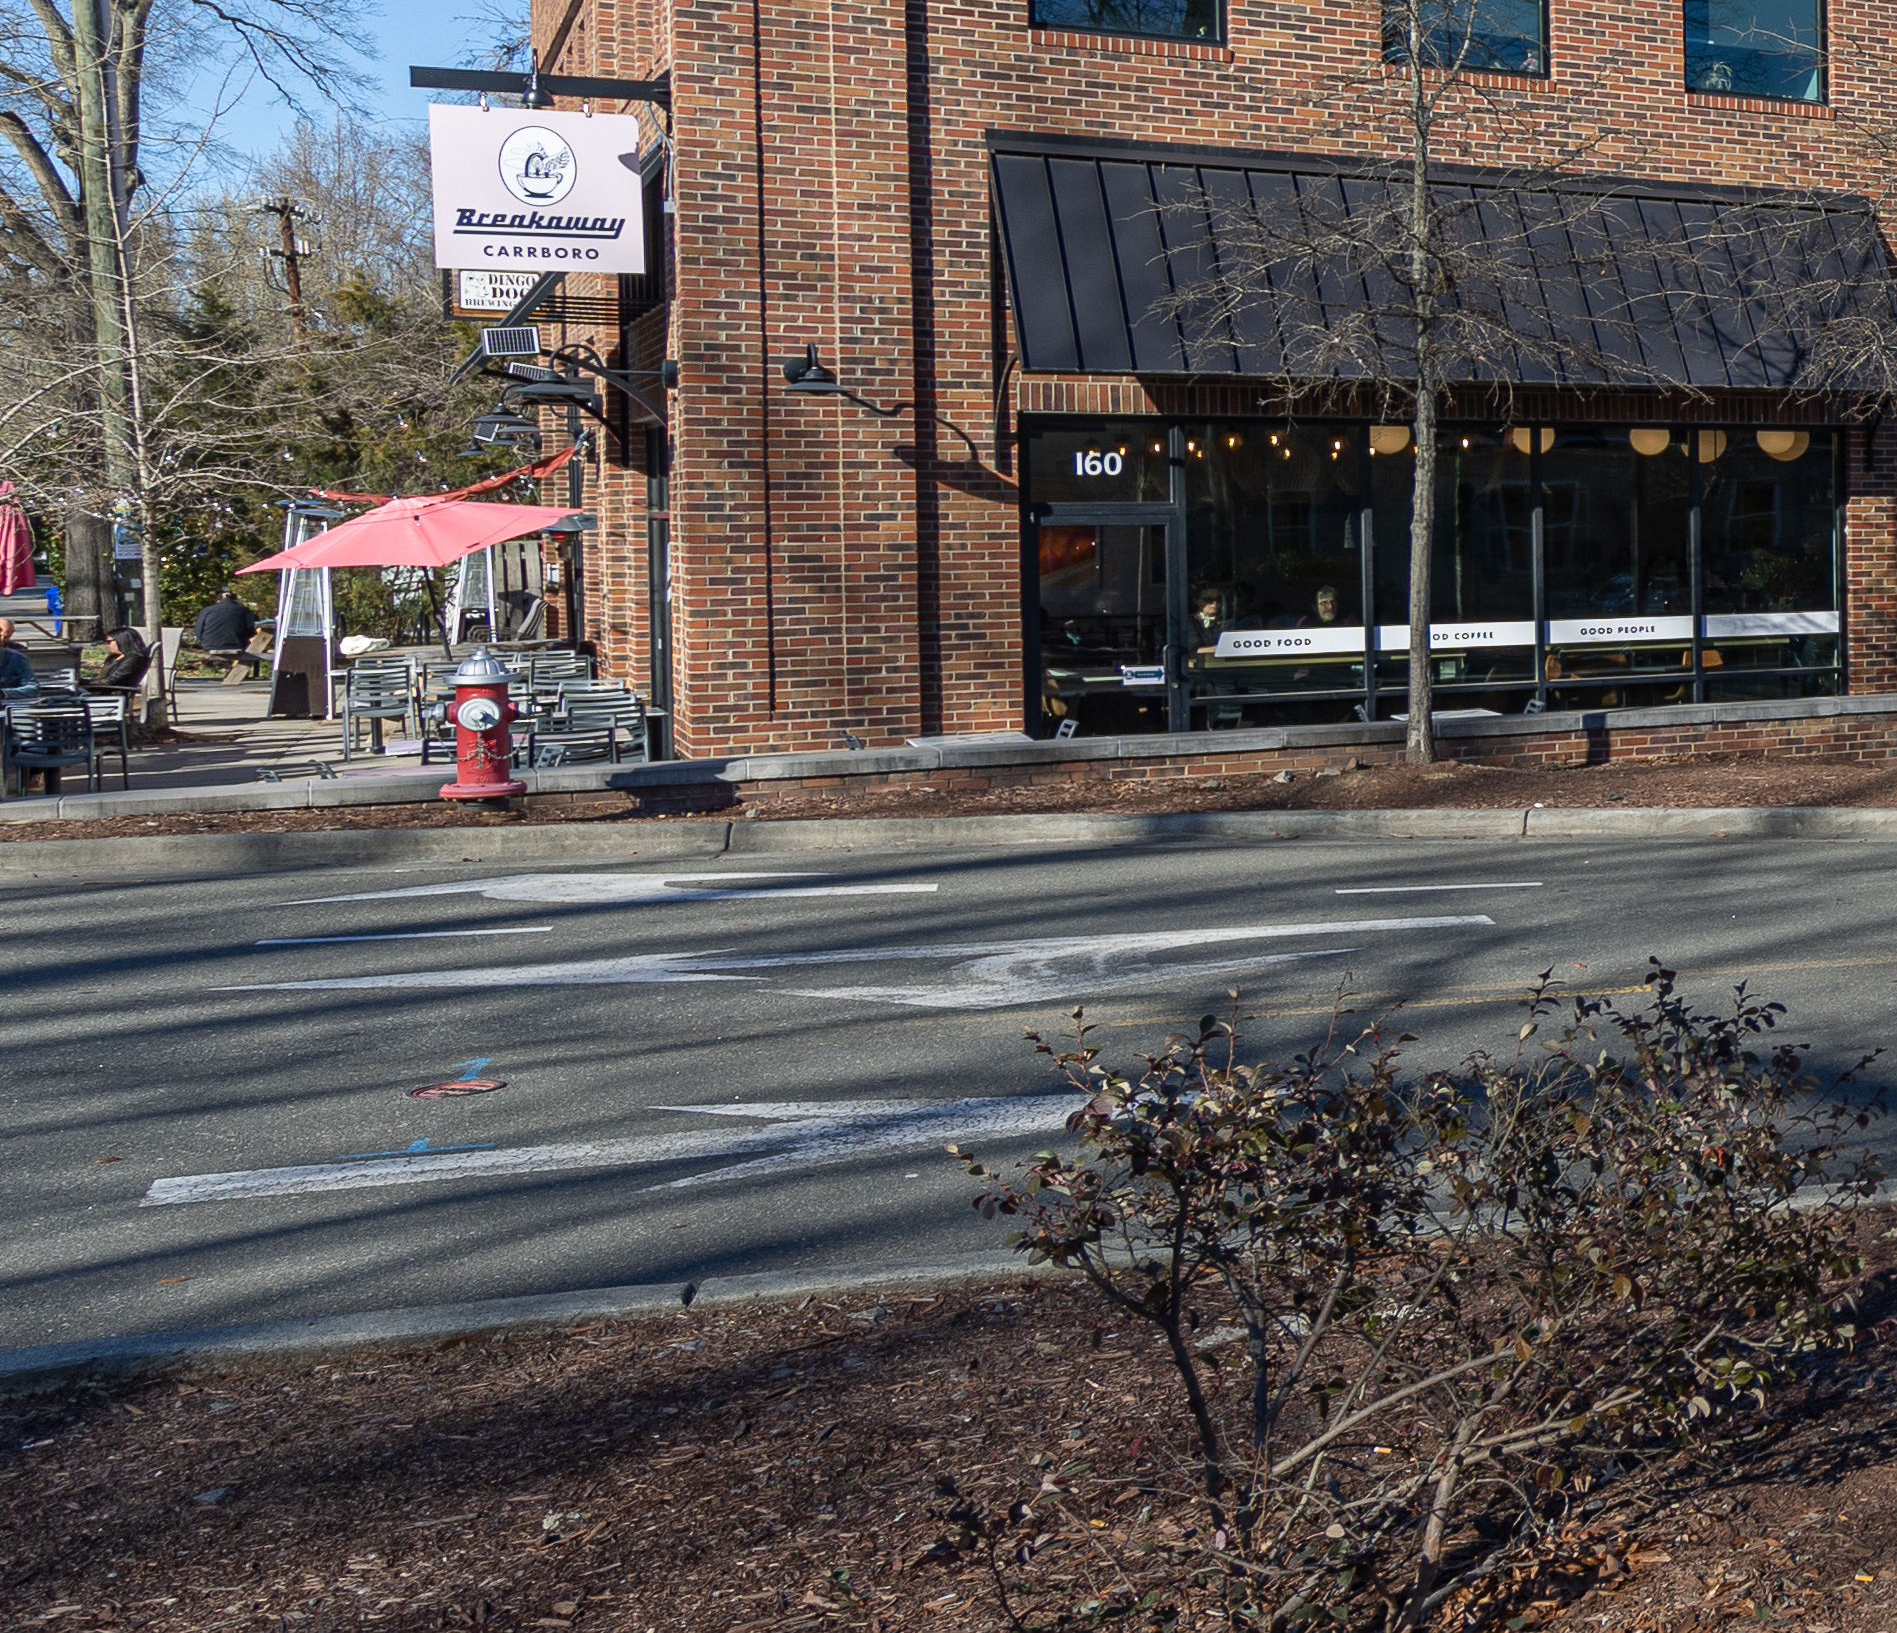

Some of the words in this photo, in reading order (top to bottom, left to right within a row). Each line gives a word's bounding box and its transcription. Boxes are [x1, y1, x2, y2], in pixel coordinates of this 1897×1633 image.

[453, 208, 626, 239] Breakaway
[483, 245, 599, 260] CARRBORO
[488, 273, 535, 286] DINGO
[1076, 452, 1122, 476] 160
[1455, 631, 1494, 640] COFFEE
[1580, 627, 1613, 635] GOOD
[1618, 625, 1655, 633] PEOPLE
[1233, 639, 1271, 648] GOOD
[1278, 638, 1311, 646] FOOD
